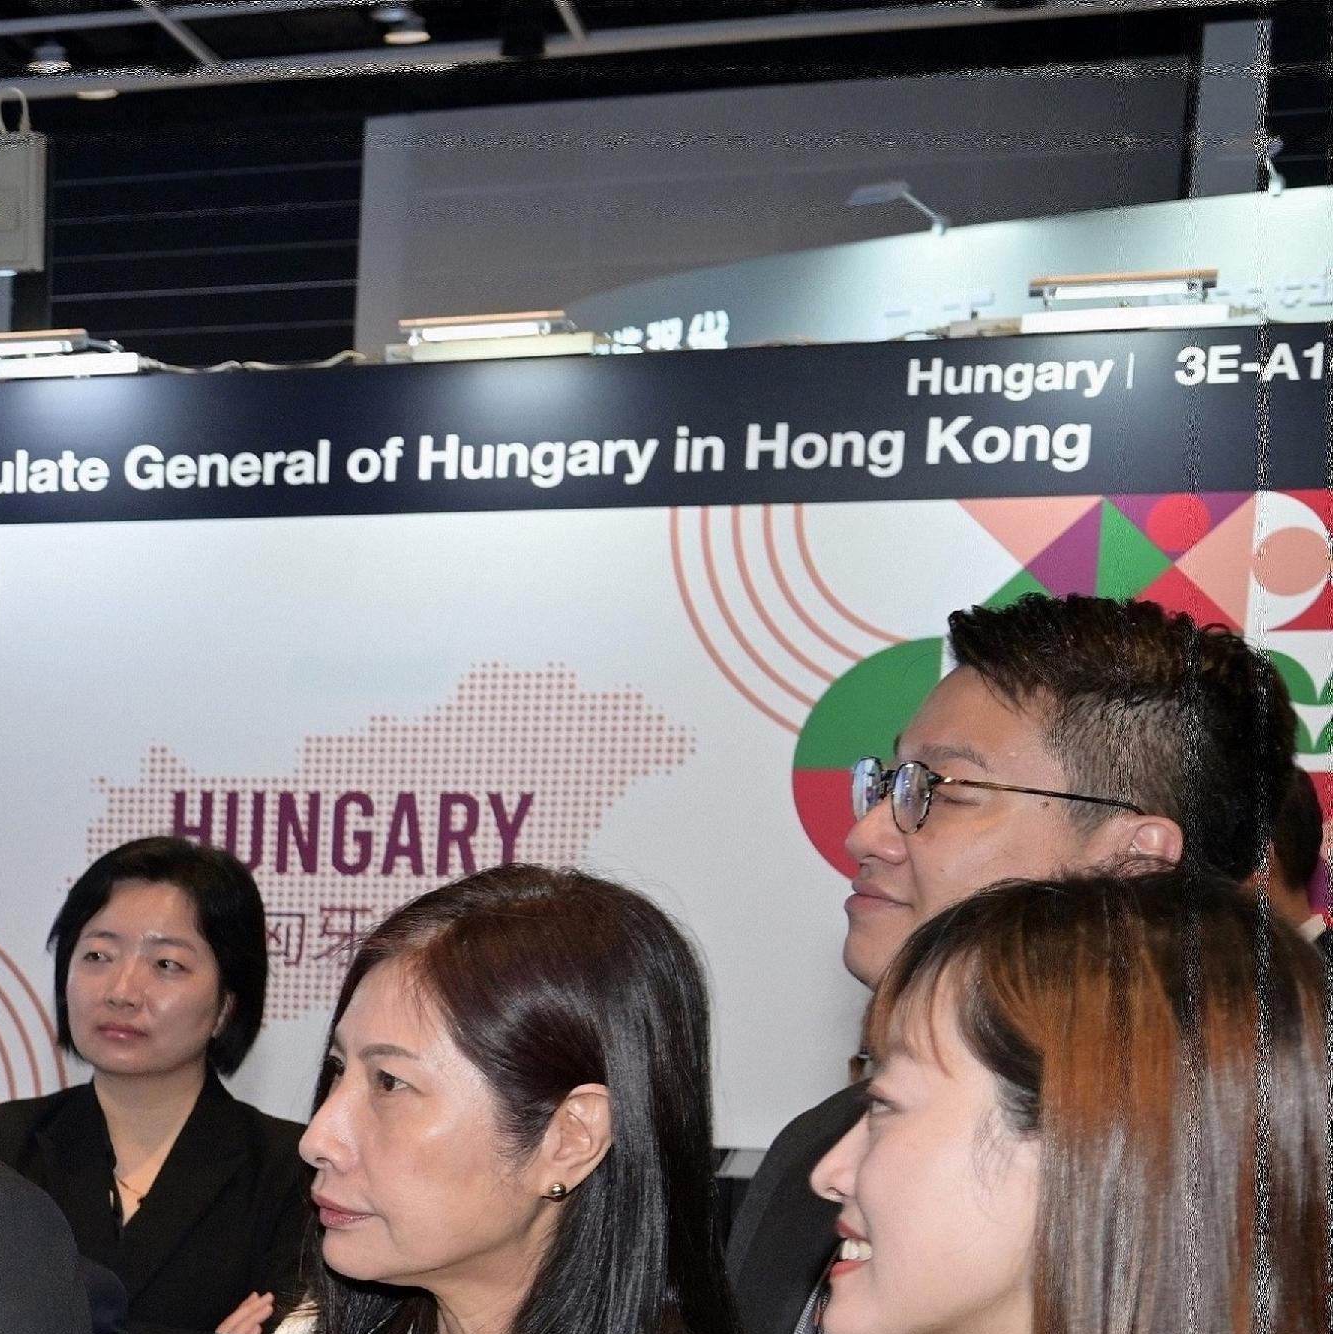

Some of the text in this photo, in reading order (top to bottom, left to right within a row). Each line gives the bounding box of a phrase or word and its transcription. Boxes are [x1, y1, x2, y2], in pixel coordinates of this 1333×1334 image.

[907, 341, 1333, 401] Hungary 3E-A1
[124, 439, 331, 491] General
[346, 436, 405, 483] of
[418, 432, 658, 488] Hungary
[673, 427, 725, 473] in
[745, 422, 906, 477] Hong
[925, 416, 1092, 472] Kong
[173, 790, 534, 876] HUNGARY
[265, 905, 374, 967] 匈牙
